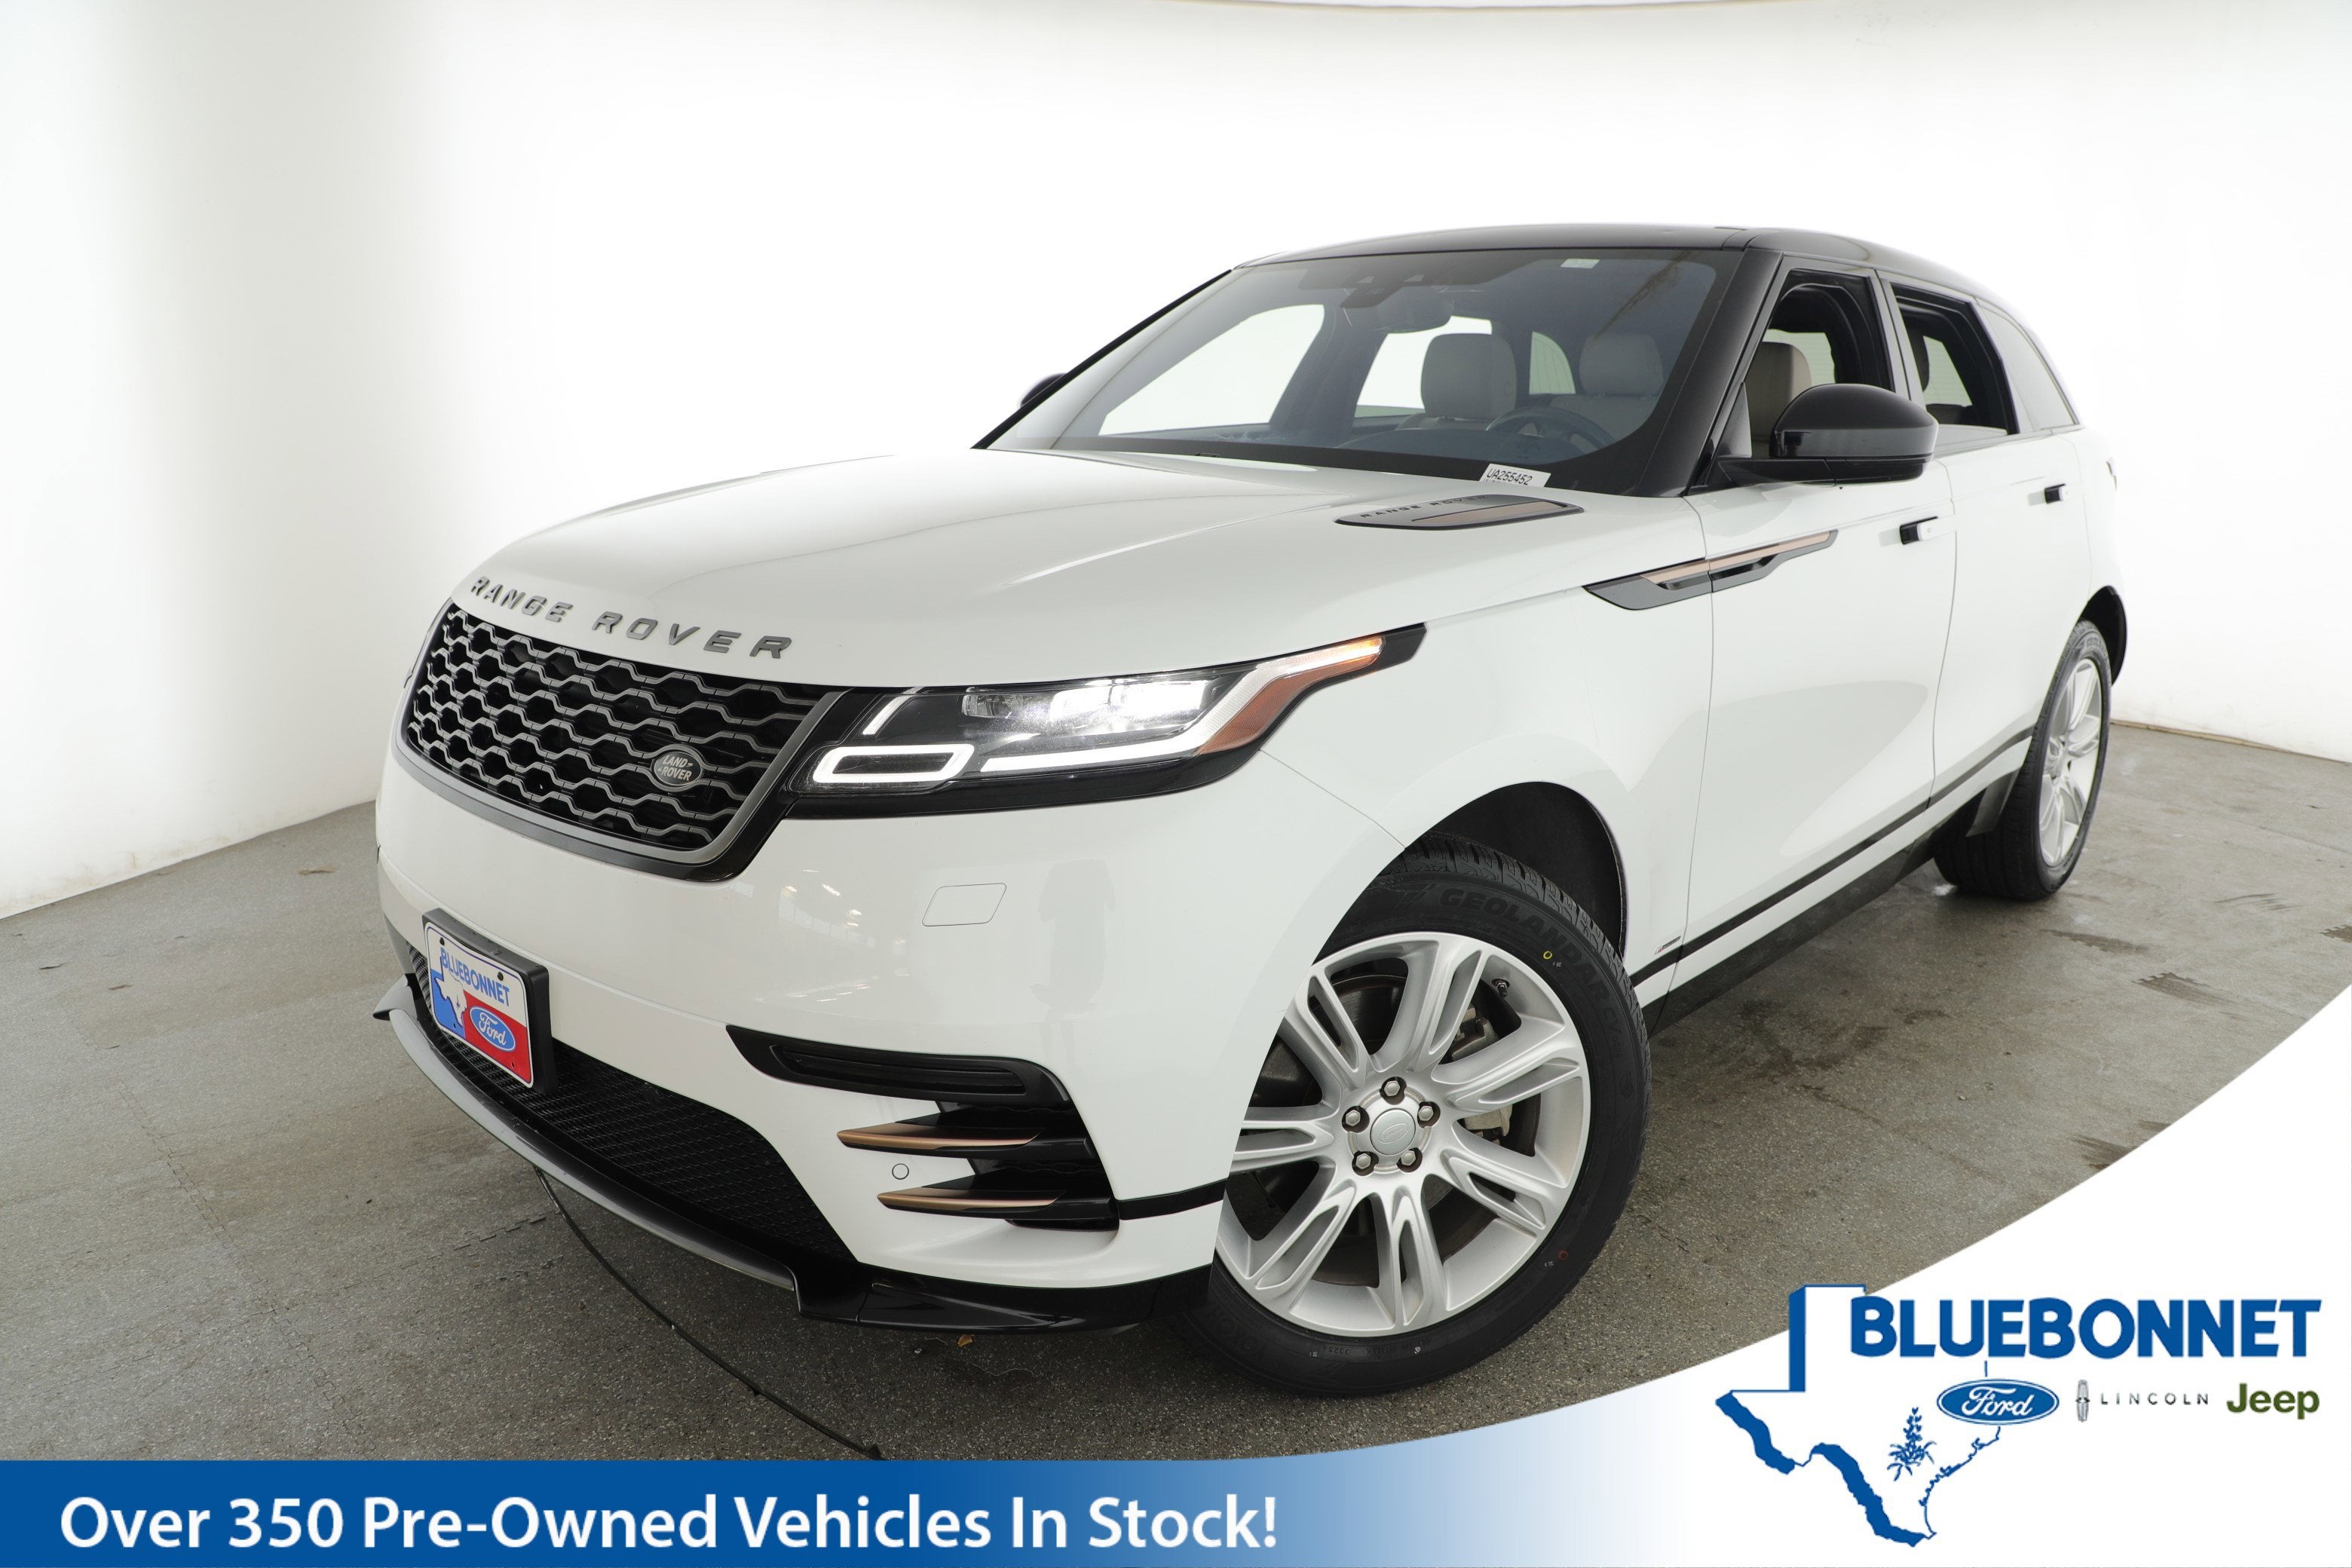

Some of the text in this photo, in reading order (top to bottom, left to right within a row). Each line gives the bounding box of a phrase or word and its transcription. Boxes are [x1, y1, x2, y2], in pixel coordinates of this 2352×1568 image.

[1487, 467, 1533, 486] UA255452
[1359, 495, 1487, 519] RANGE ROVER
[470, 575, 792, 659] RANGE ROVER
[660, 755, 693, 781] LAND ROVER
[1439, 887, 1611, 1006] GEOLANDAR
[440, 947, 510, 1007] BLUEBONNET
[478, 1012, 507, 1046] Ford
